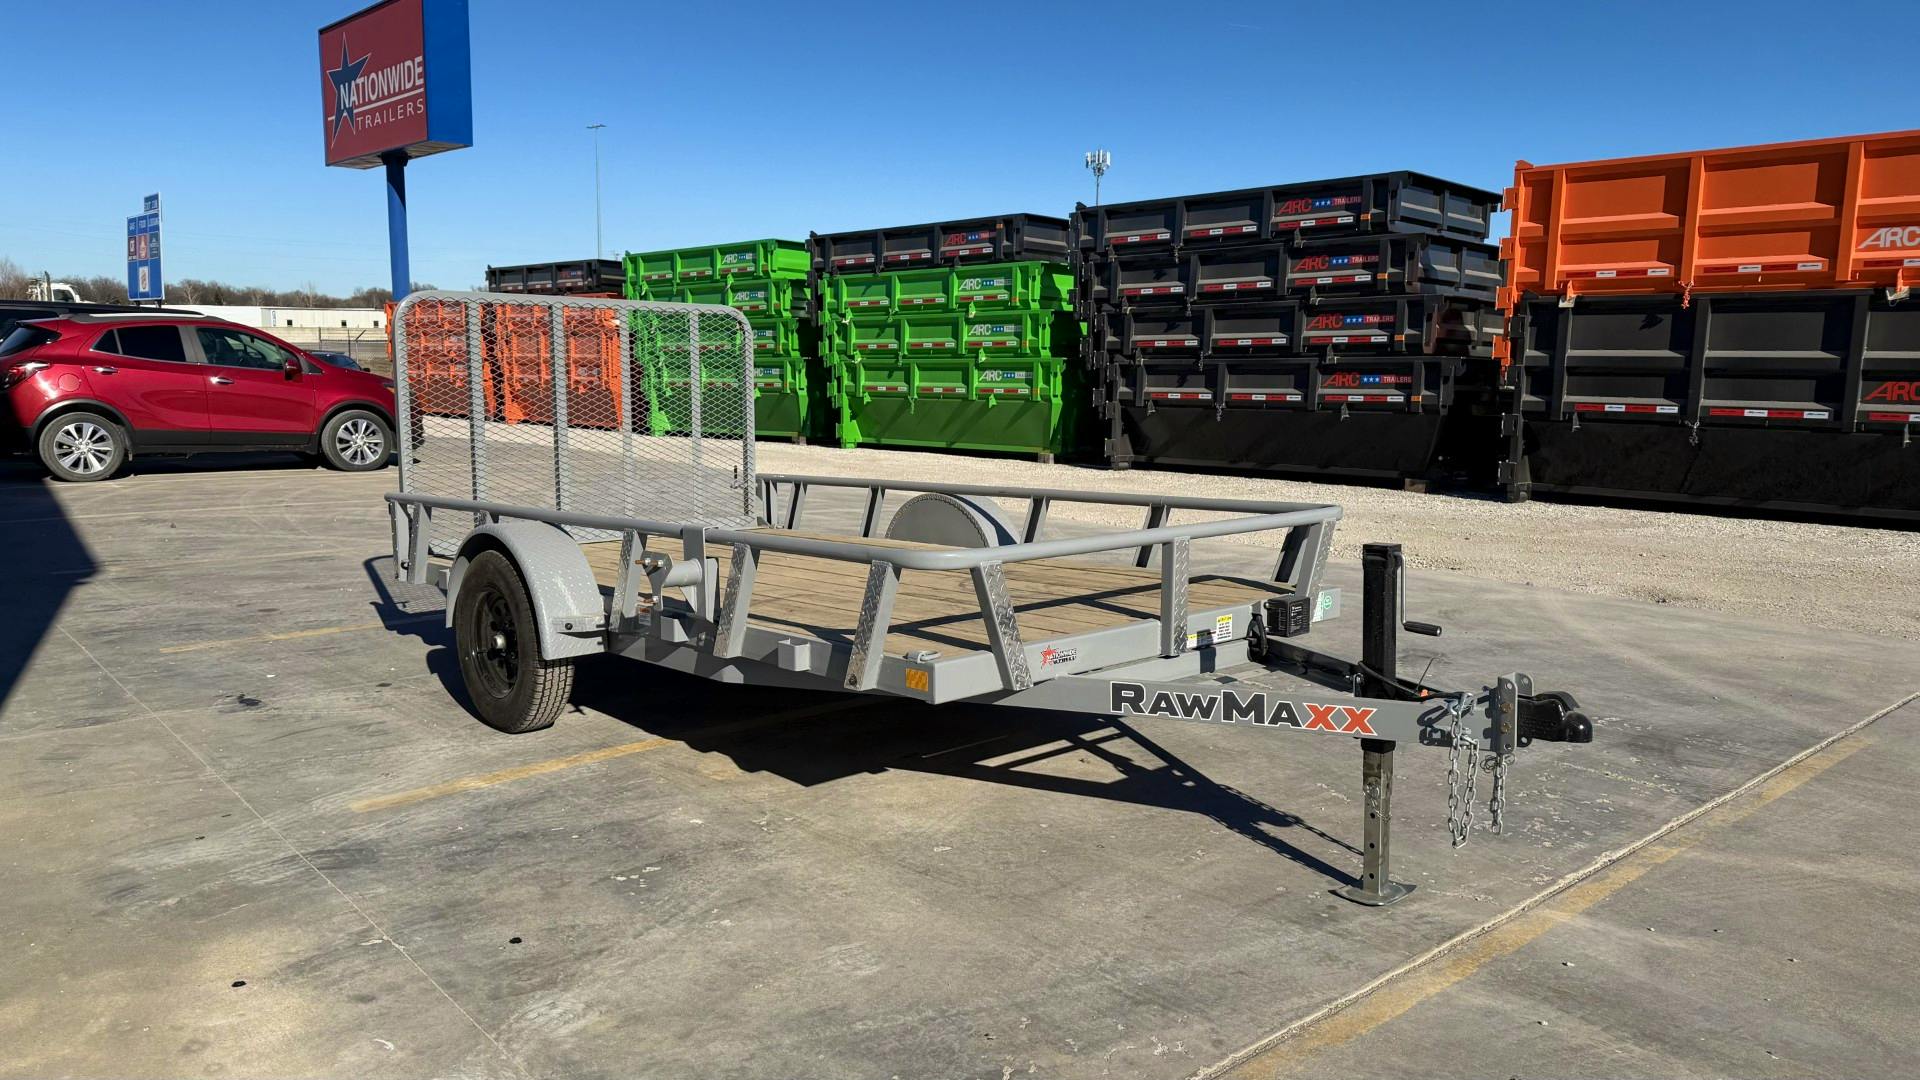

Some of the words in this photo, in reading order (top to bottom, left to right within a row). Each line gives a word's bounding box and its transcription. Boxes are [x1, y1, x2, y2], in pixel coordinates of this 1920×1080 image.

[340, 56, 424, 110] NATIONWIDE
[357, 99, 424, 130] TRAILERS
[1279, 198, 1313, 214] ARC
[943, 232, 967, 247] ARC
[1857, 226, 1920, 249] ARC
[1294, 255, 1329, 271] ARC
[959, 278, 981, 290] ARC
[1307, 313, 1344, 330] ARC
[968, 324, 991, 336] ARC
[979, 370, 1002, 382] ARC
[1323, 372, 1360, 388] ARC
[1383, 375, 1412, 384] TRAILERS
